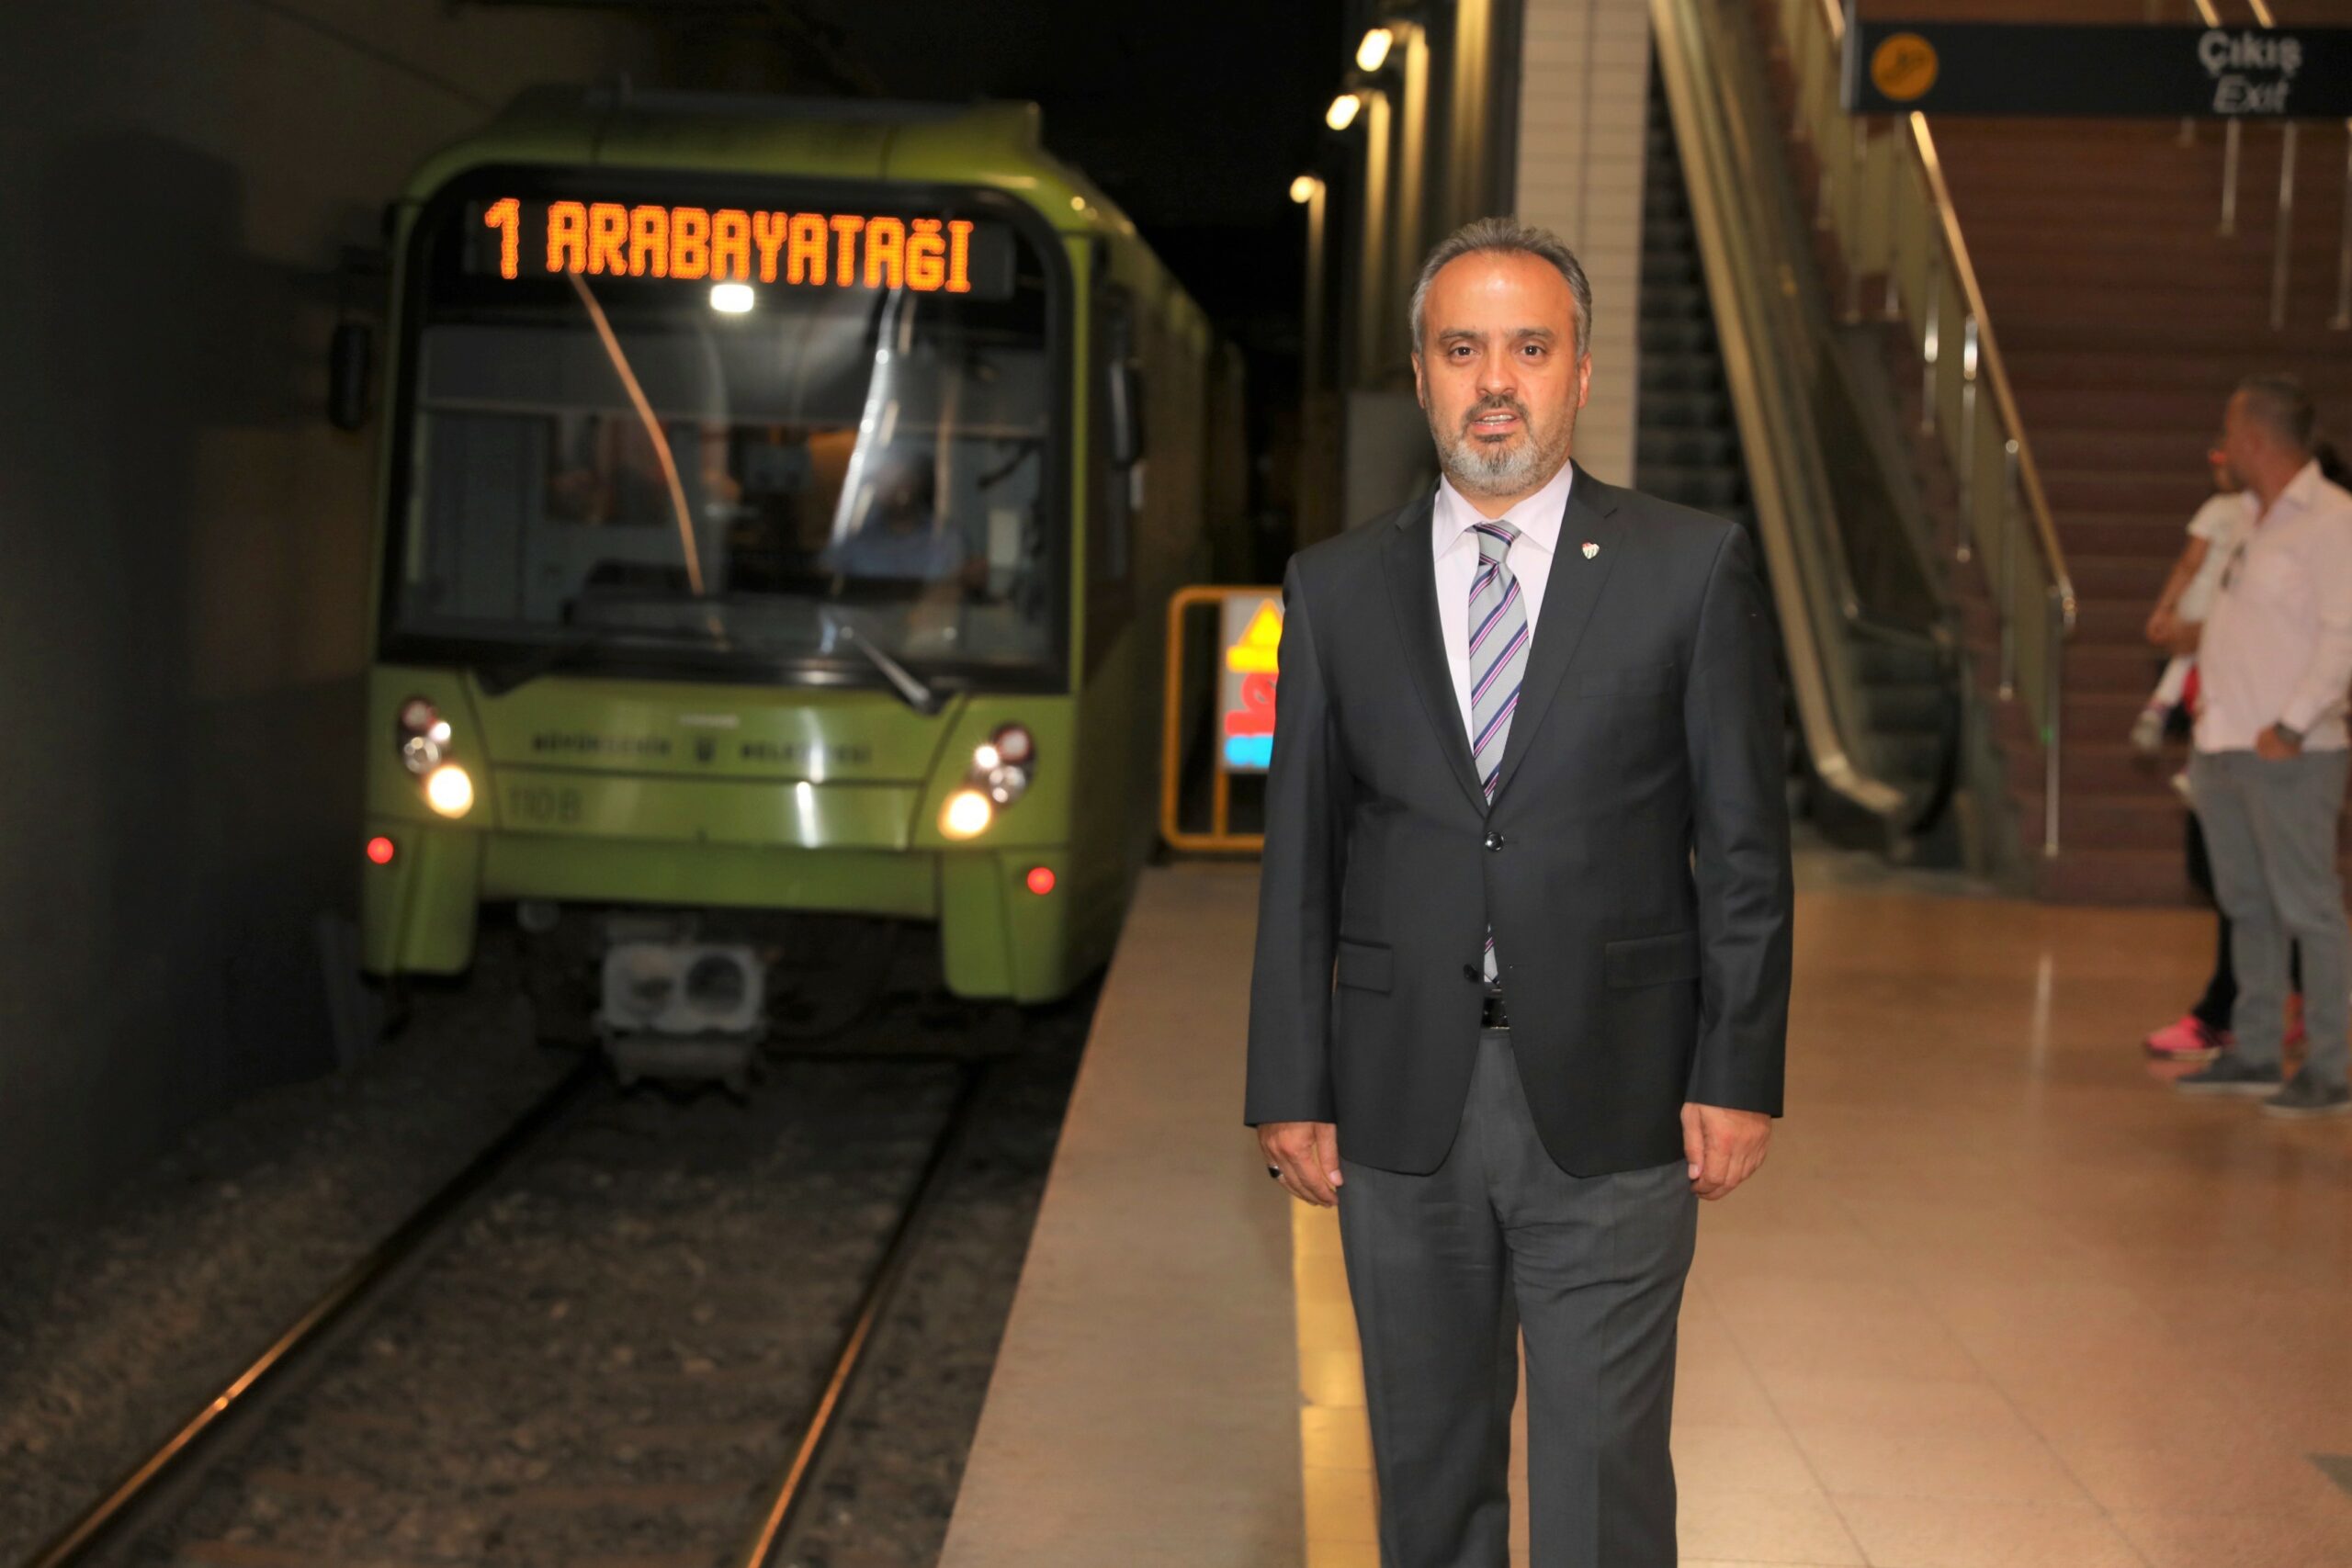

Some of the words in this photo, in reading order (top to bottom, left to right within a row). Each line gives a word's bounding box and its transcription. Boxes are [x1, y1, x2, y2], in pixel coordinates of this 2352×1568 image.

[2199, 30, 2301, 78] Çıkış
[2212, 75, 2290, 113] Exit
[484, 197, 520, 279] 1
[546, 200, 974, 293] ARABAYATAĞI
